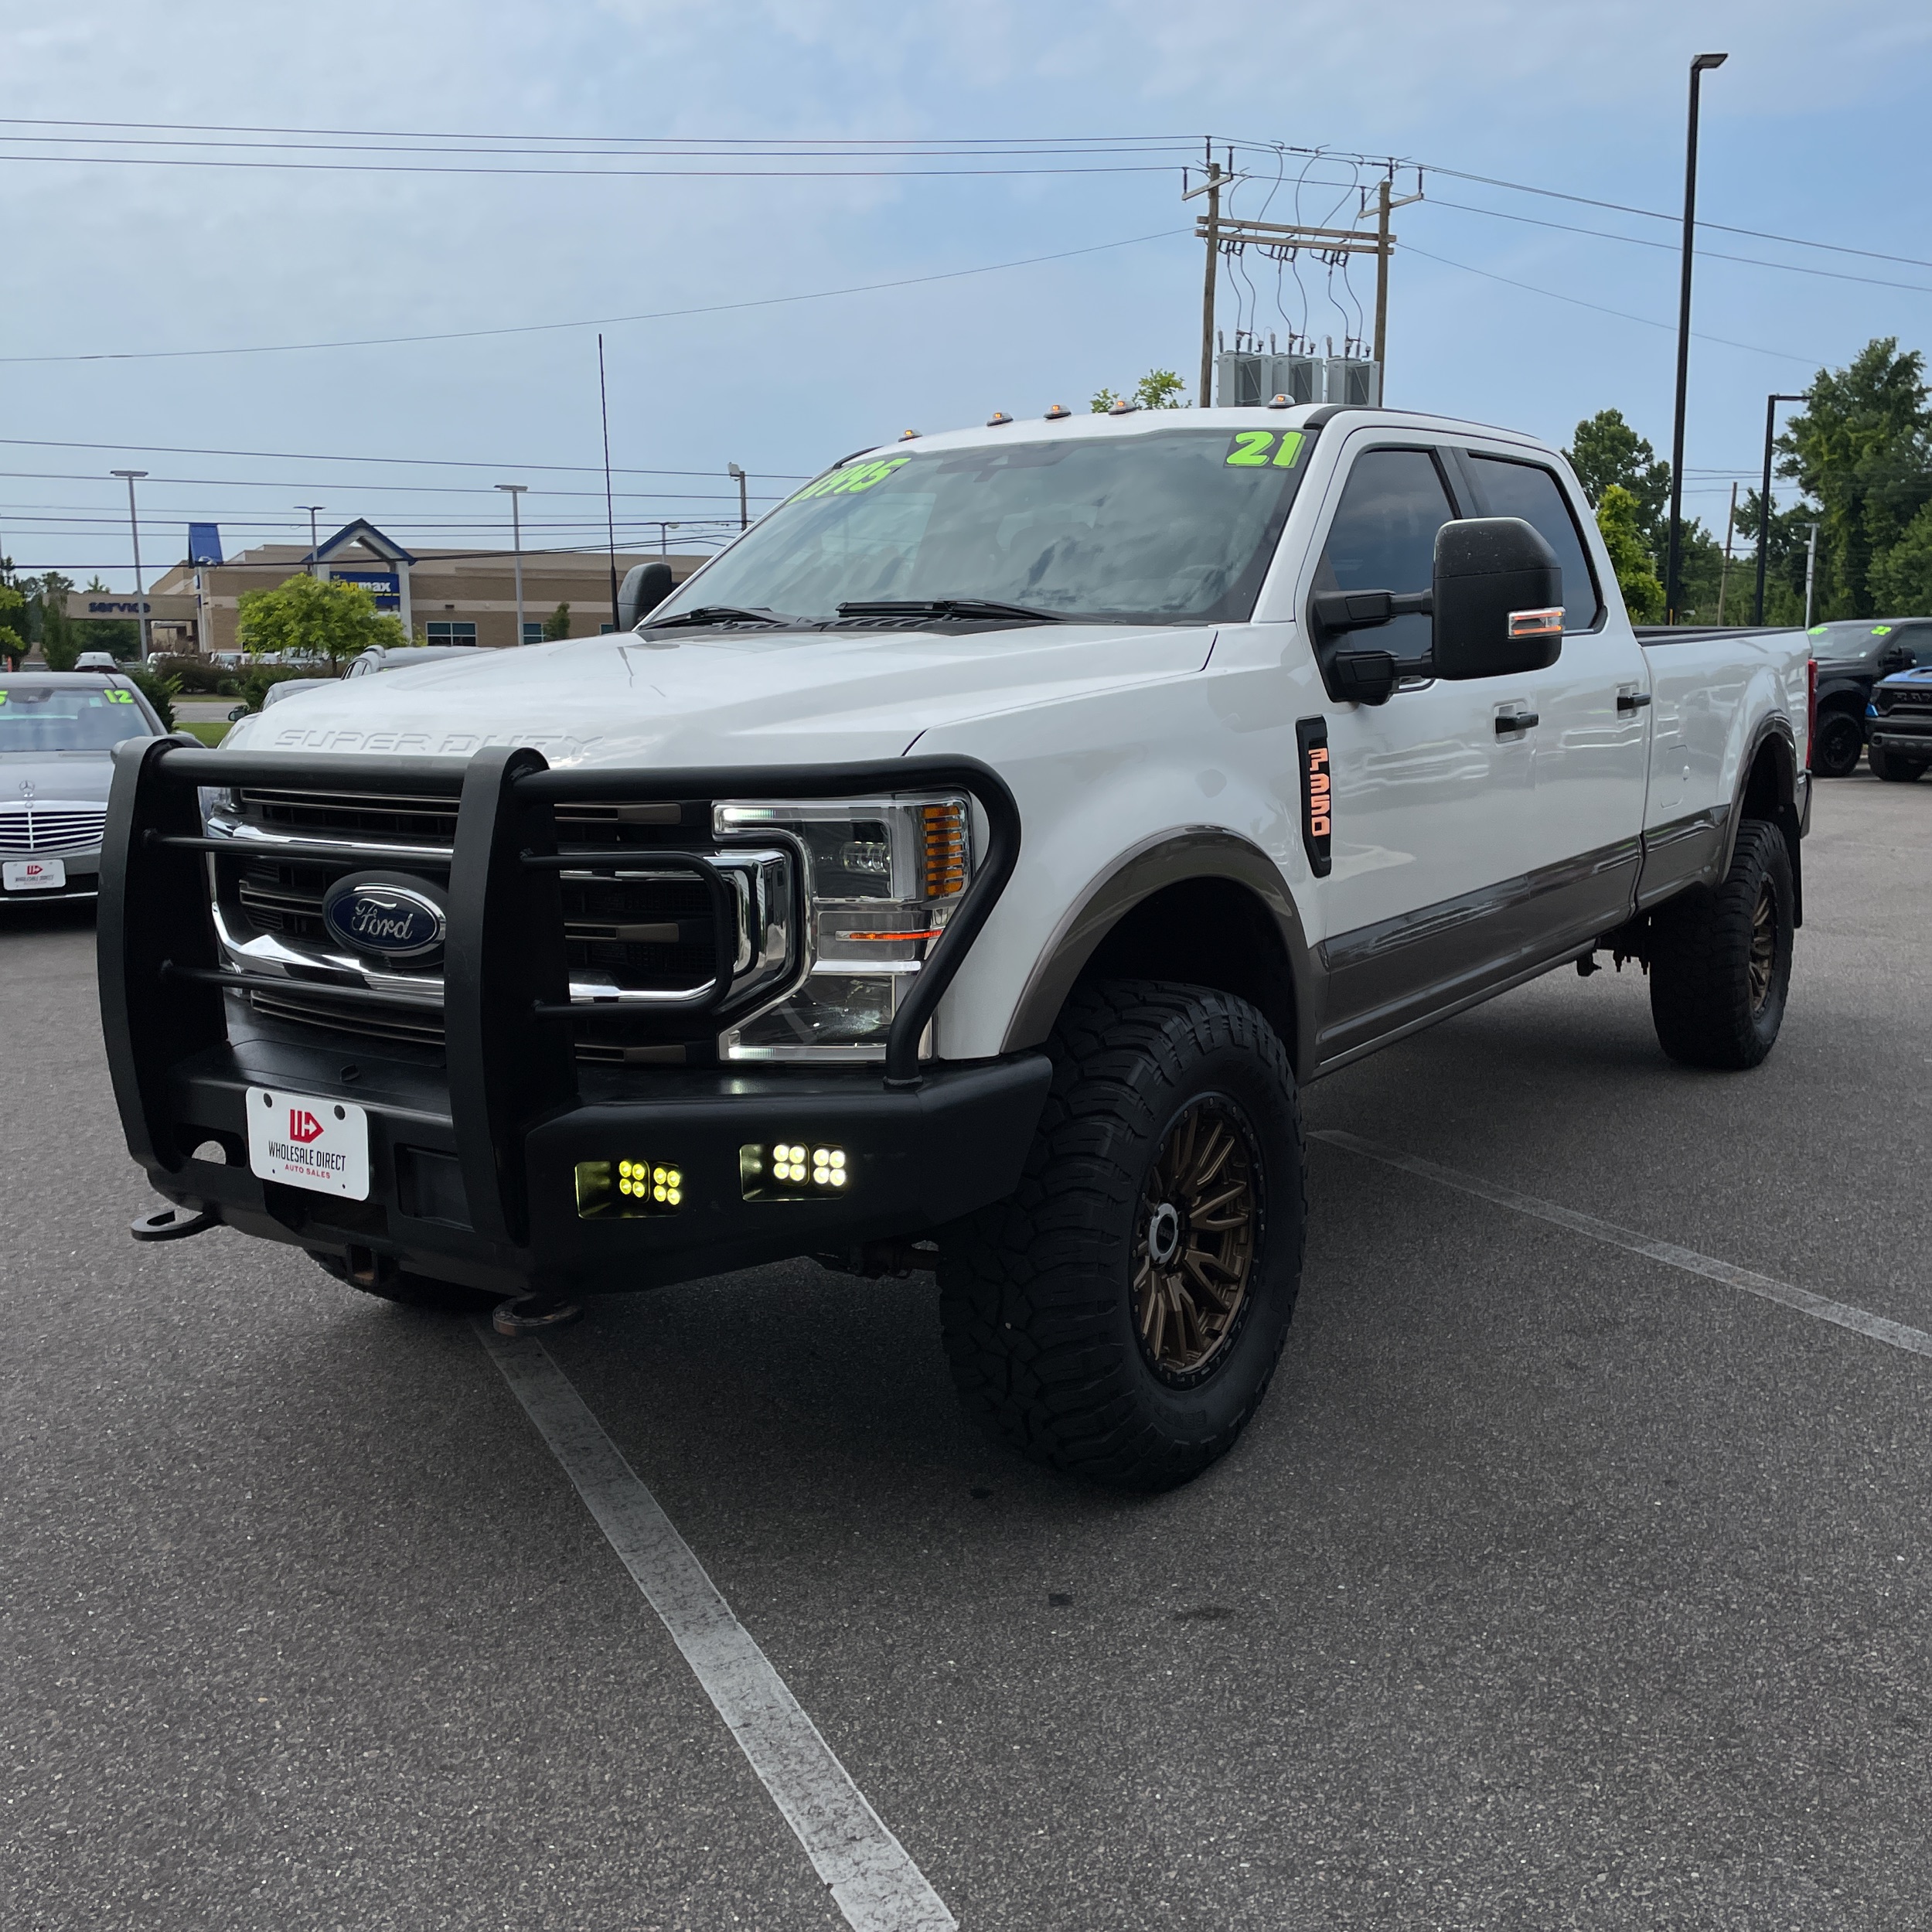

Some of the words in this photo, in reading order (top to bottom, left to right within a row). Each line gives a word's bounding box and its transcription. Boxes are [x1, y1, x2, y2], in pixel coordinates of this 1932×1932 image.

[1226, 431, 1307, 468] 21
[104, 689, 135, 704] 12
[274, 729, 432, 753] SUPER
[351, 898, 414, 940] Ford
[267, 1140, 314, 1167] WHOLESALE
[316, 1150, 346, 1172] DIRECT
[285, 1164, 305, 1174] AUTO
[306, 1167, 331, 1180] SALES
